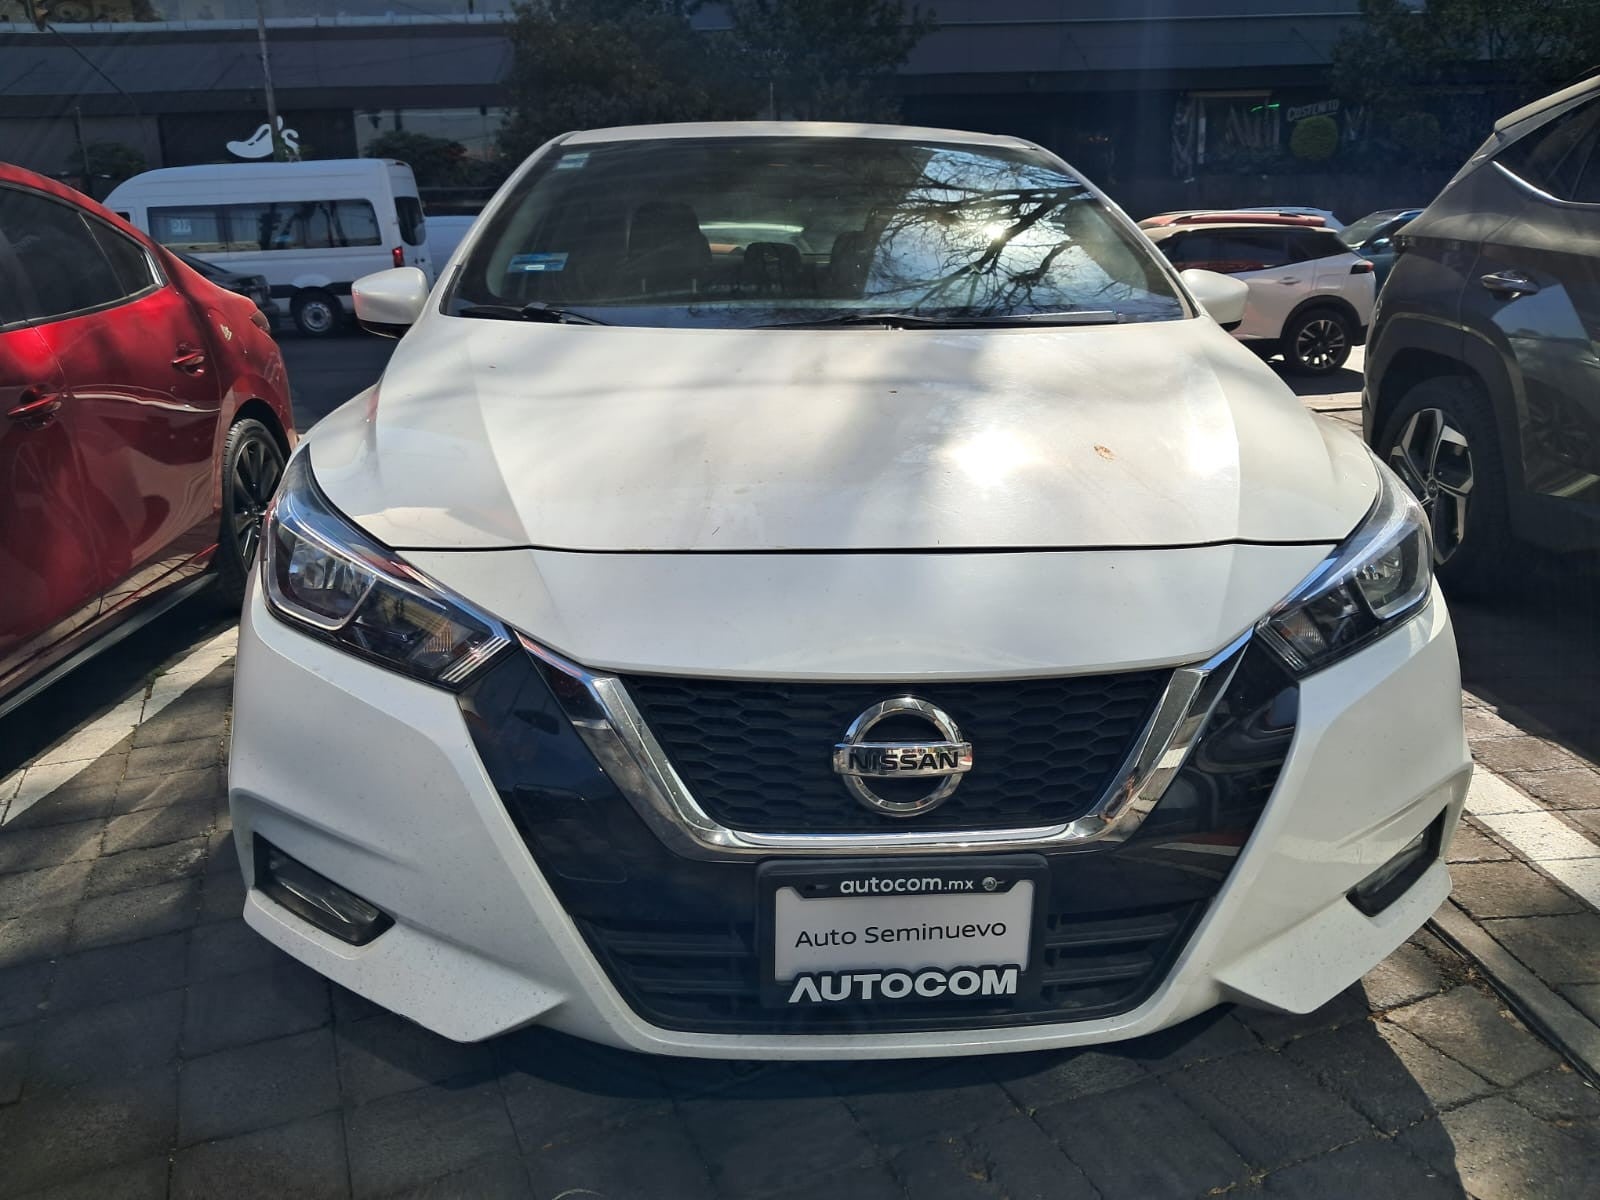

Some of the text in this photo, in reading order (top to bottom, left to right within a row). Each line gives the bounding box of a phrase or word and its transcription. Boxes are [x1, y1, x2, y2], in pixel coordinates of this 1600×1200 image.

[848, 751, 959, 771] NISSAN
[839, 876, 974, 894] autocom.mx
[795, 921, 1007, 948] Auto Seminuevo
[788, 968, 1018, 1003] AUTOCOM
